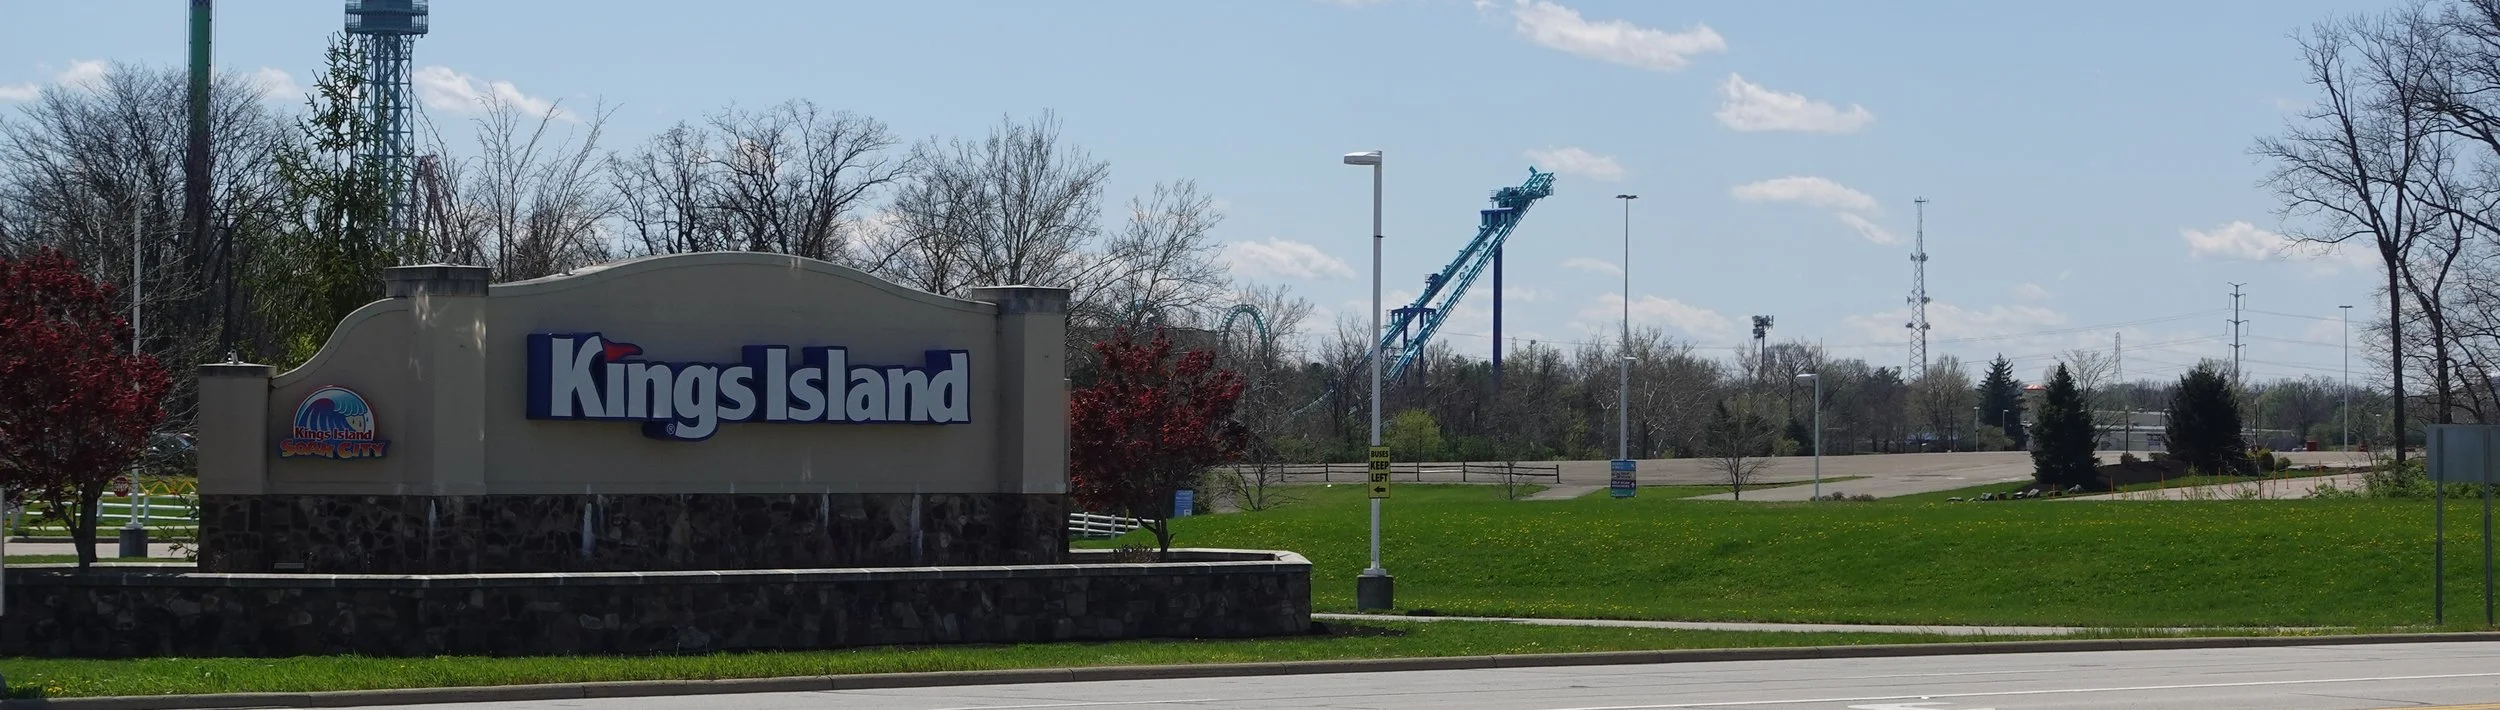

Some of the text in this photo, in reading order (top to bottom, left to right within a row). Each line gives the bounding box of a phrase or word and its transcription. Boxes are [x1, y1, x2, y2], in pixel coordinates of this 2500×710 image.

[551, 335, 969, 439] Kings Island
[294, 427, 372, 441] Kings Island
[337, 441, 385, 459] CITY
[1370, 450, 1389, 458] BUSES
[1370, 460, 1389, 470] KEEP
[1371, 473, 1389, 482] LEFT
